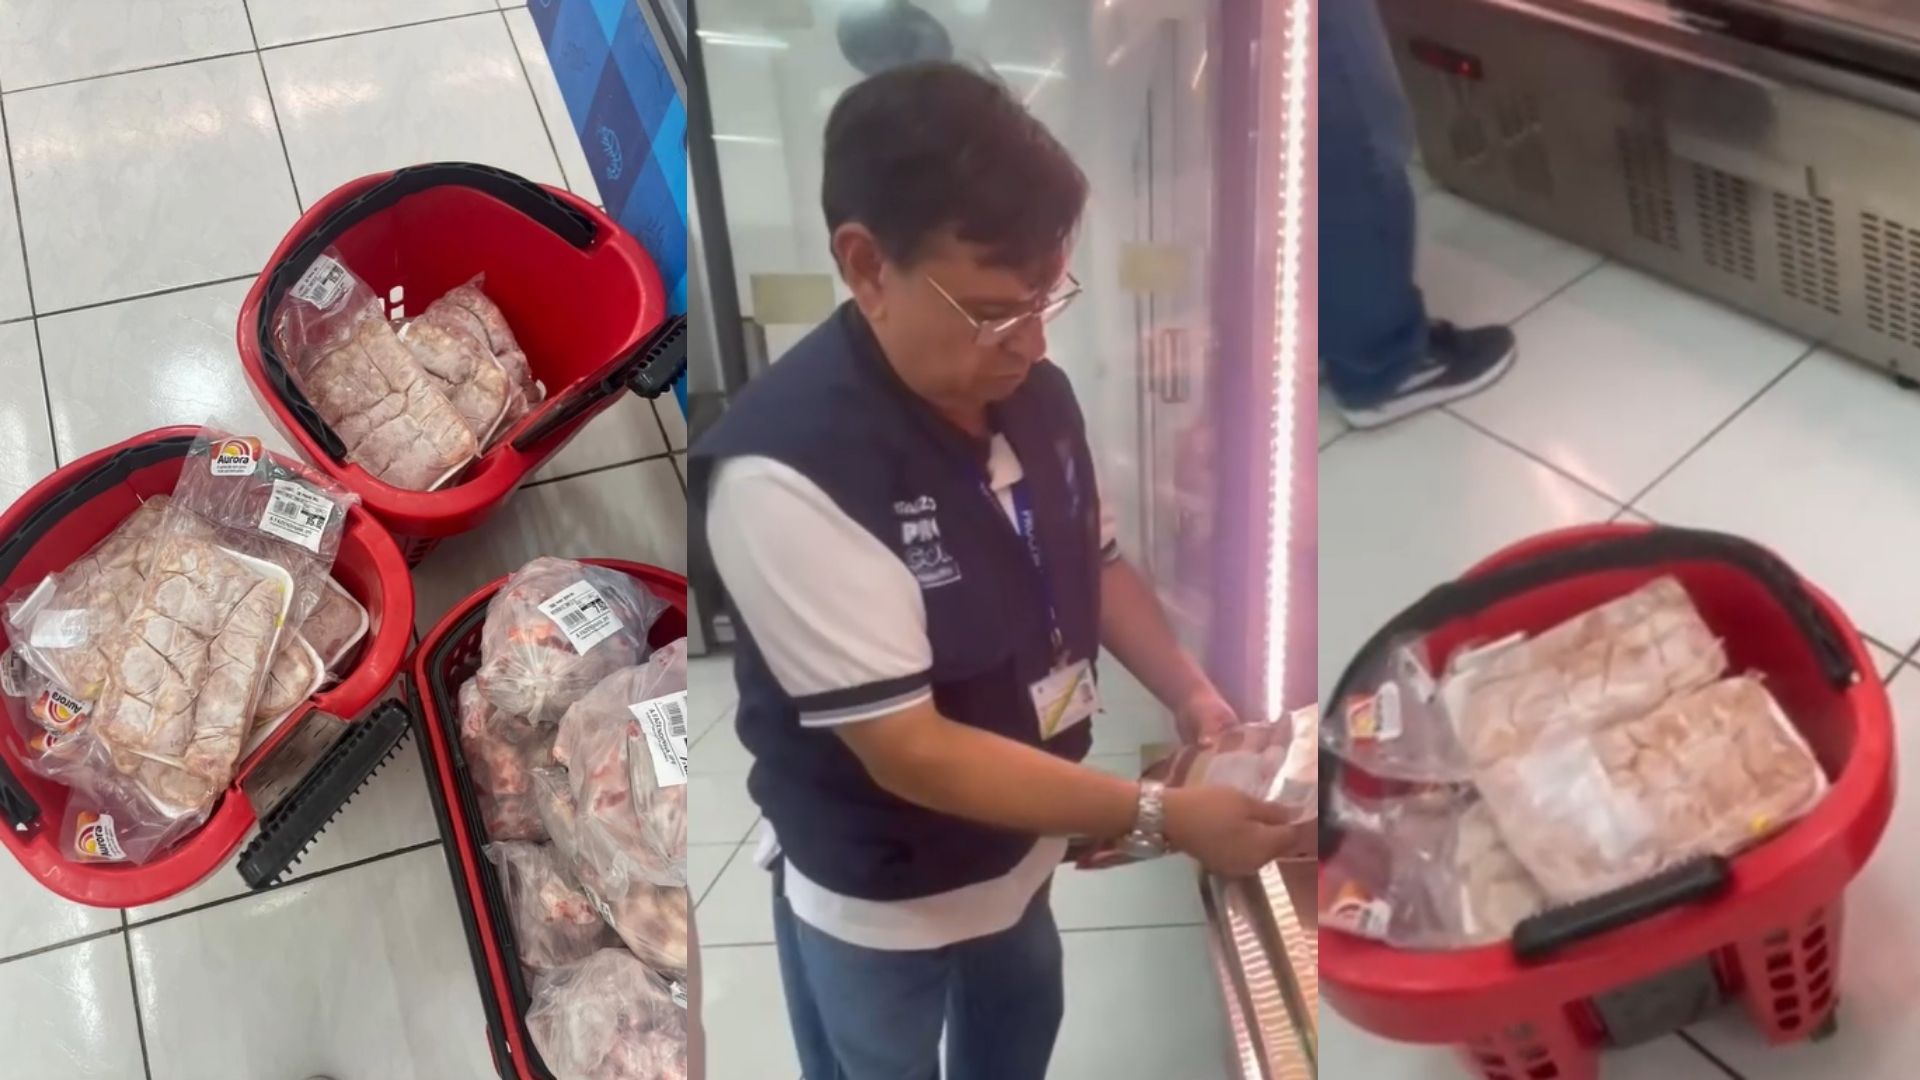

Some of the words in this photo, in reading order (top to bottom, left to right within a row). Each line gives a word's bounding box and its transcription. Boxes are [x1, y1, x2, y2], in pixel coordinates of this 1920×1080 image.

[217, 455, 249, 464] Aurora
[52, 691, 82, 714] Aurora
[95, 825, 112, 857] Aurora
